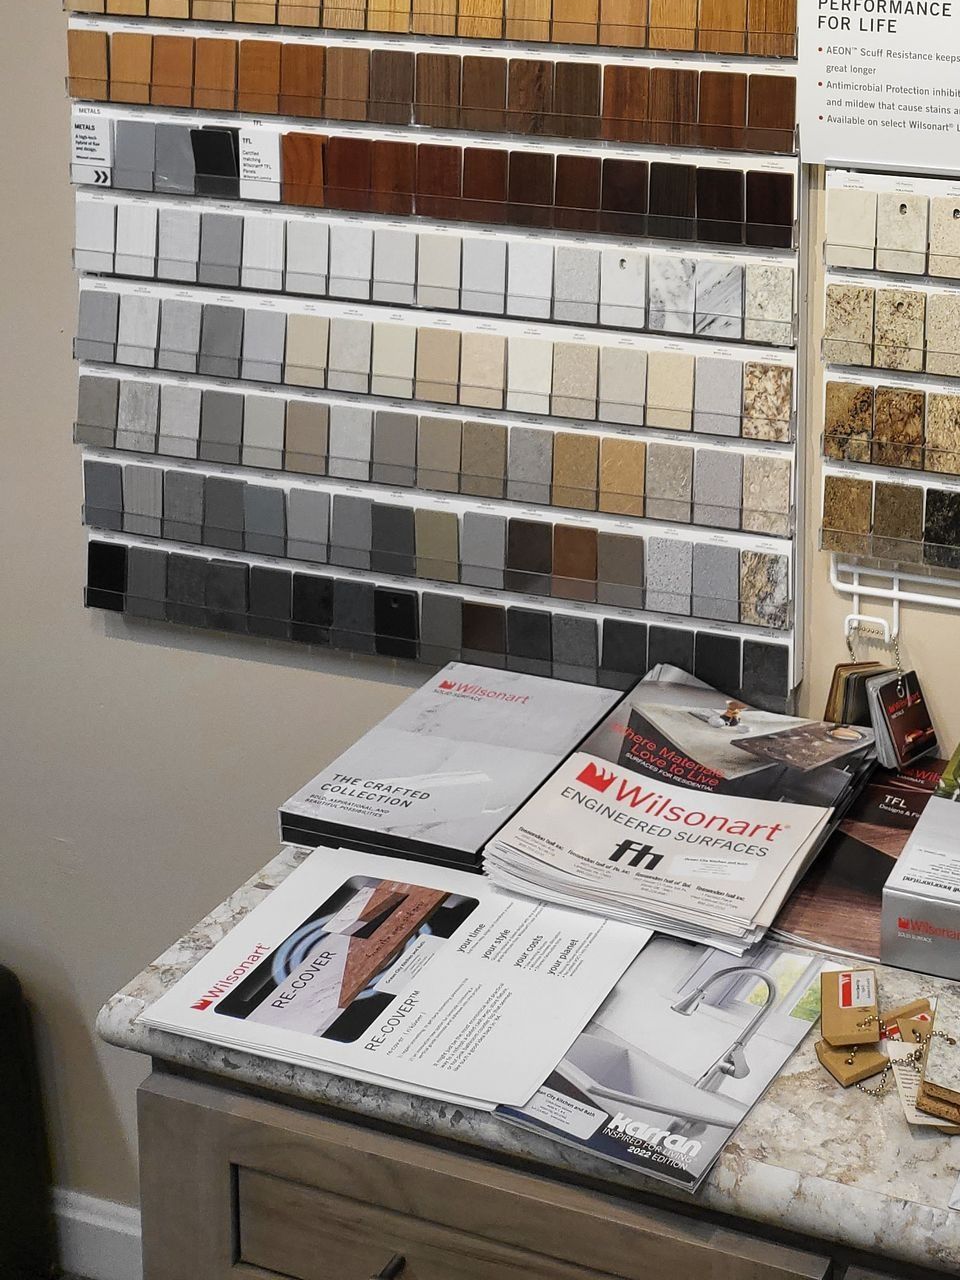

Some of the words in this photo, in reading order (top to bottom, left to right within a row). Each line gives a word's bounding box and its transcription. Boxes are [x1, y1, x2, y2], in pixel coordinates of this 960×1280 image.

[818, 15, 851, 31] FOR
[860, 18, 897, 33] LIFE
[860, 47, 883, 58] Scuff
[886, 49, 933, 61] Resistance
[935, 52, 960, 64] keeps
[826, 66, 848, 75] great
[850, 65, 876, 76] longer
[827, 81, 883, 93] Antimicrobial
[886, 84, 930, 96] Protection
[826, 98, 842, 108] and
[844, 98, 875, 109] mildew
[878, 101, 895, 111] that
[897, 104, 923, 113] cause
[925, 105, 951, 115] stains
[74, 123, 95, 131] METALS
[827, 115, 865, 126] Available
[867, 118, 878, 126] on
[880, 119, 906, 128] select
[625, 752, 659, 773] SURFACES
[658, 769, 674, 780] FOR
[673, 775, 715, 792] RESIDENTIAL
[630, 743, 667, 769] Love
[669, 764, 685, 777] to
[687, 770, 720, 787] Live
[320, 783, 413, 808] COLLECTION
[332, 773, 362, 786] THE
[363, 781, 431, 800] CRAFTED
[879, 803, 904, 816] Designs
[885, 795, 907, 808] TFL
[560, 786, 672, 838] ENGINEERED
[674, 831, 769, 857] SURFACES
[608, 839, 665, 871] fh
[456, 939, 473, 954] your
[469, 922, 486, 941] time
[482, 943, 499, 961] your
[494, 928, 512, 950] style
[513, 951, 530, 969] your
[526, 934, 544, 955] costs
[547, 958, 564, 976] your
[560, 938, 579, 963] planet
[202, 942, 271, 1001] Wilsonart
[271, 950, 337, 1009] RE-COVER
[602, 1127, 642, 1147] INSPIRED
[643, 1141, 663, 1153] FOR
[661, 1148, 692, 1163] LIVING
[627, 1146, 652, 1158] 2022
[651, 1151, 689, 1171] EDITION
